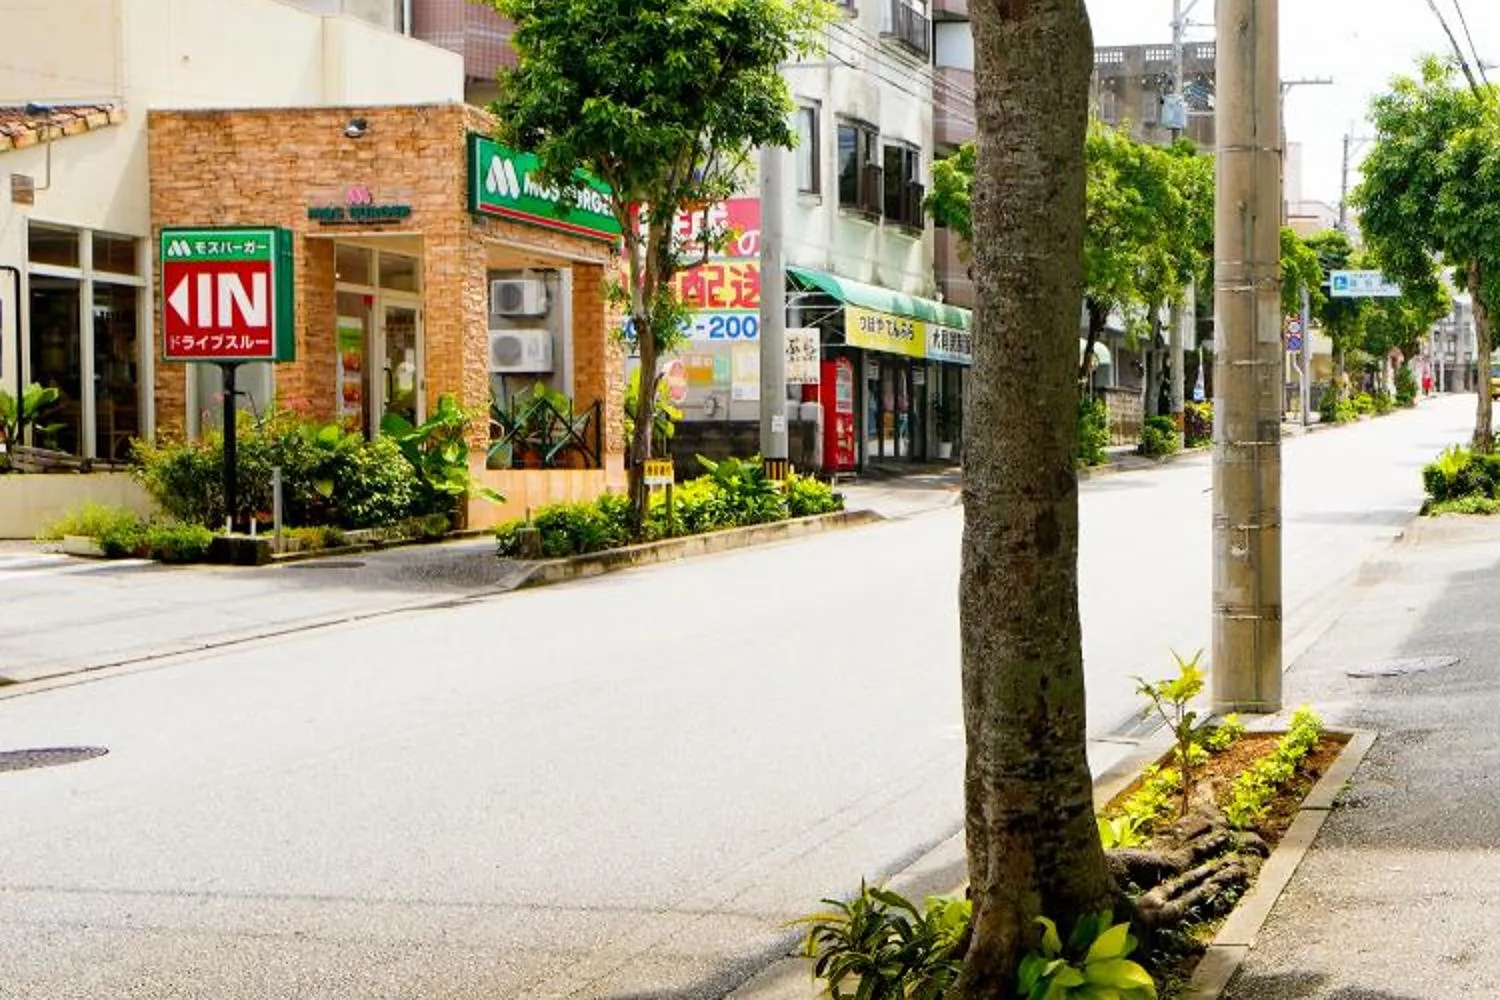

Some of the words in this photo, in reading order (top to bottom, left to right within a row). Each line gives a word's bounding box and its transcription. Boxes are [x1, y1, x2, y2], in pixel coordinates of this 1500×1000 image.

[194, 240, 268, 255] モスバーガー
[197, 272, 267, 328] IN
[169, 333, 270, 351] ドライブスルー
